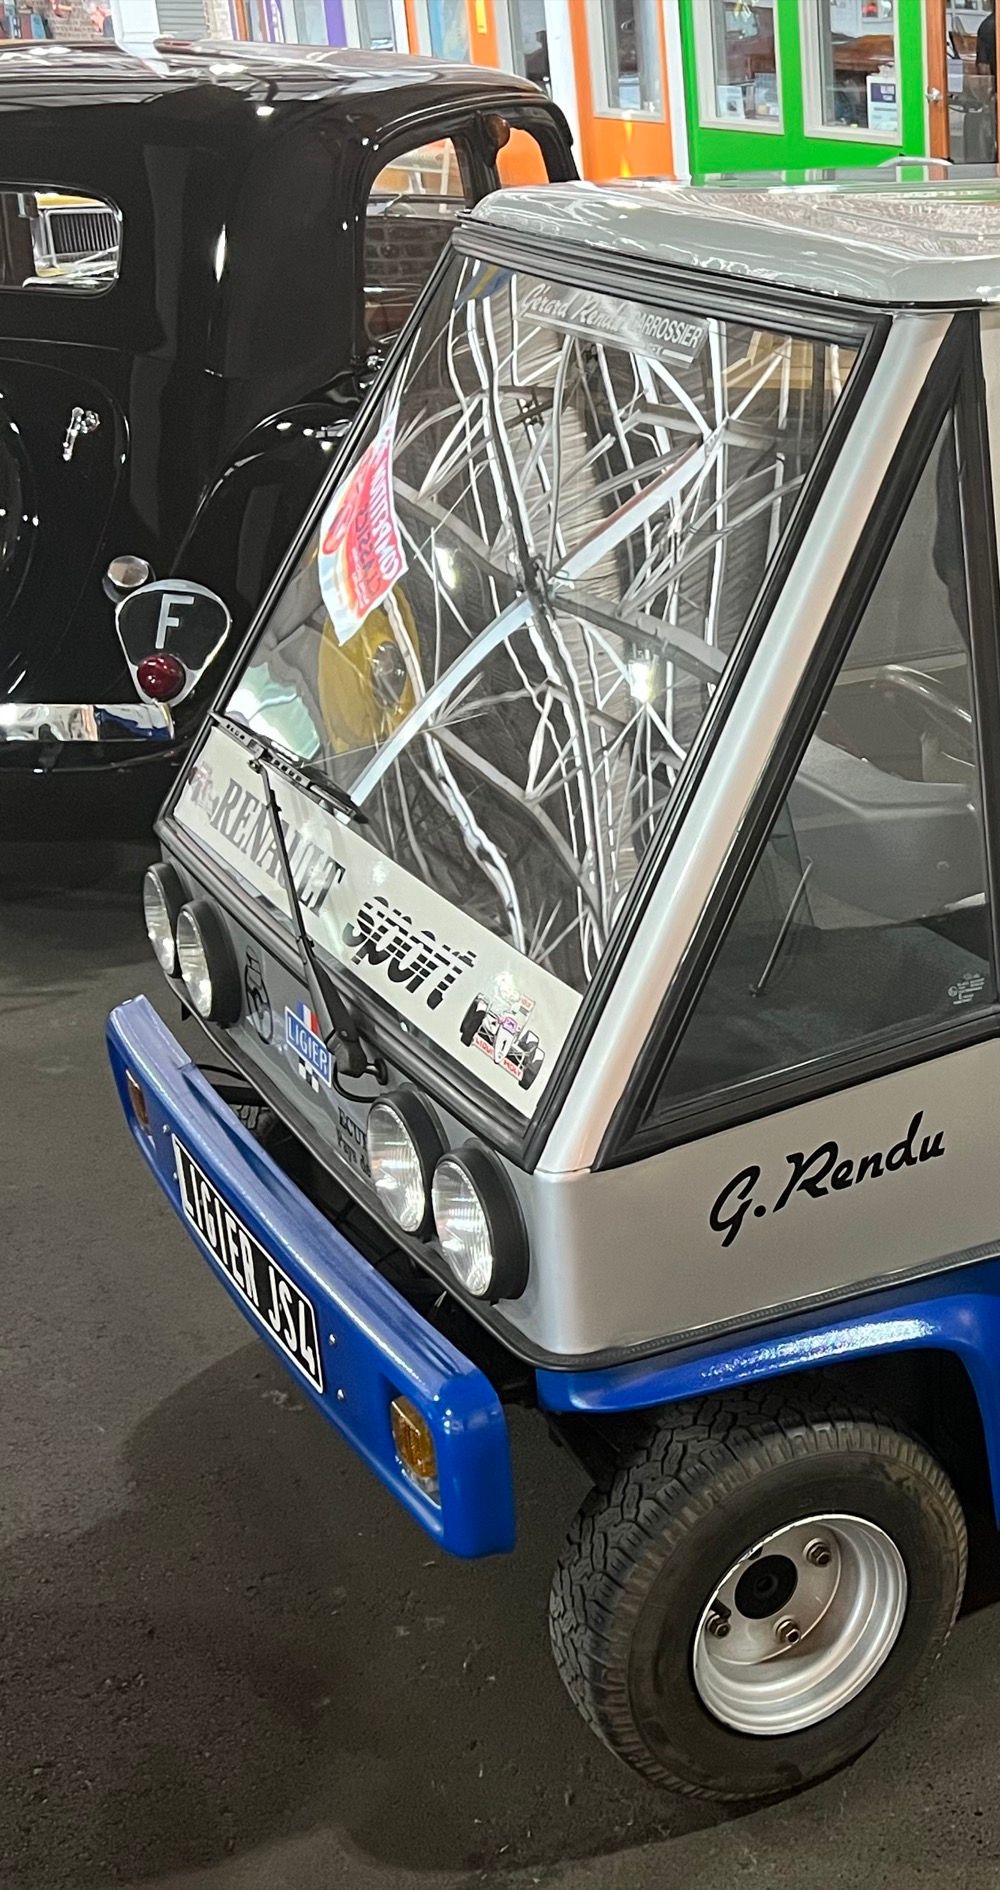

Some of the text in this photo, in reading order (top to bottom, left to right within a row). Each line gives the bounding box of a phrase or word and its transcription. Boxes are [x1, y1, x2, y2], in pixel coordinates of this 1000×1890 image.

[155, 593, 195, 649] F
[209, 777, 346, 918] RENAULT
[288, 1016, 328, 1076] LIGIER
[503, 1059, 522, 1078] MOLY
[179, 1145, 316, 1377] LIGIER JS4
